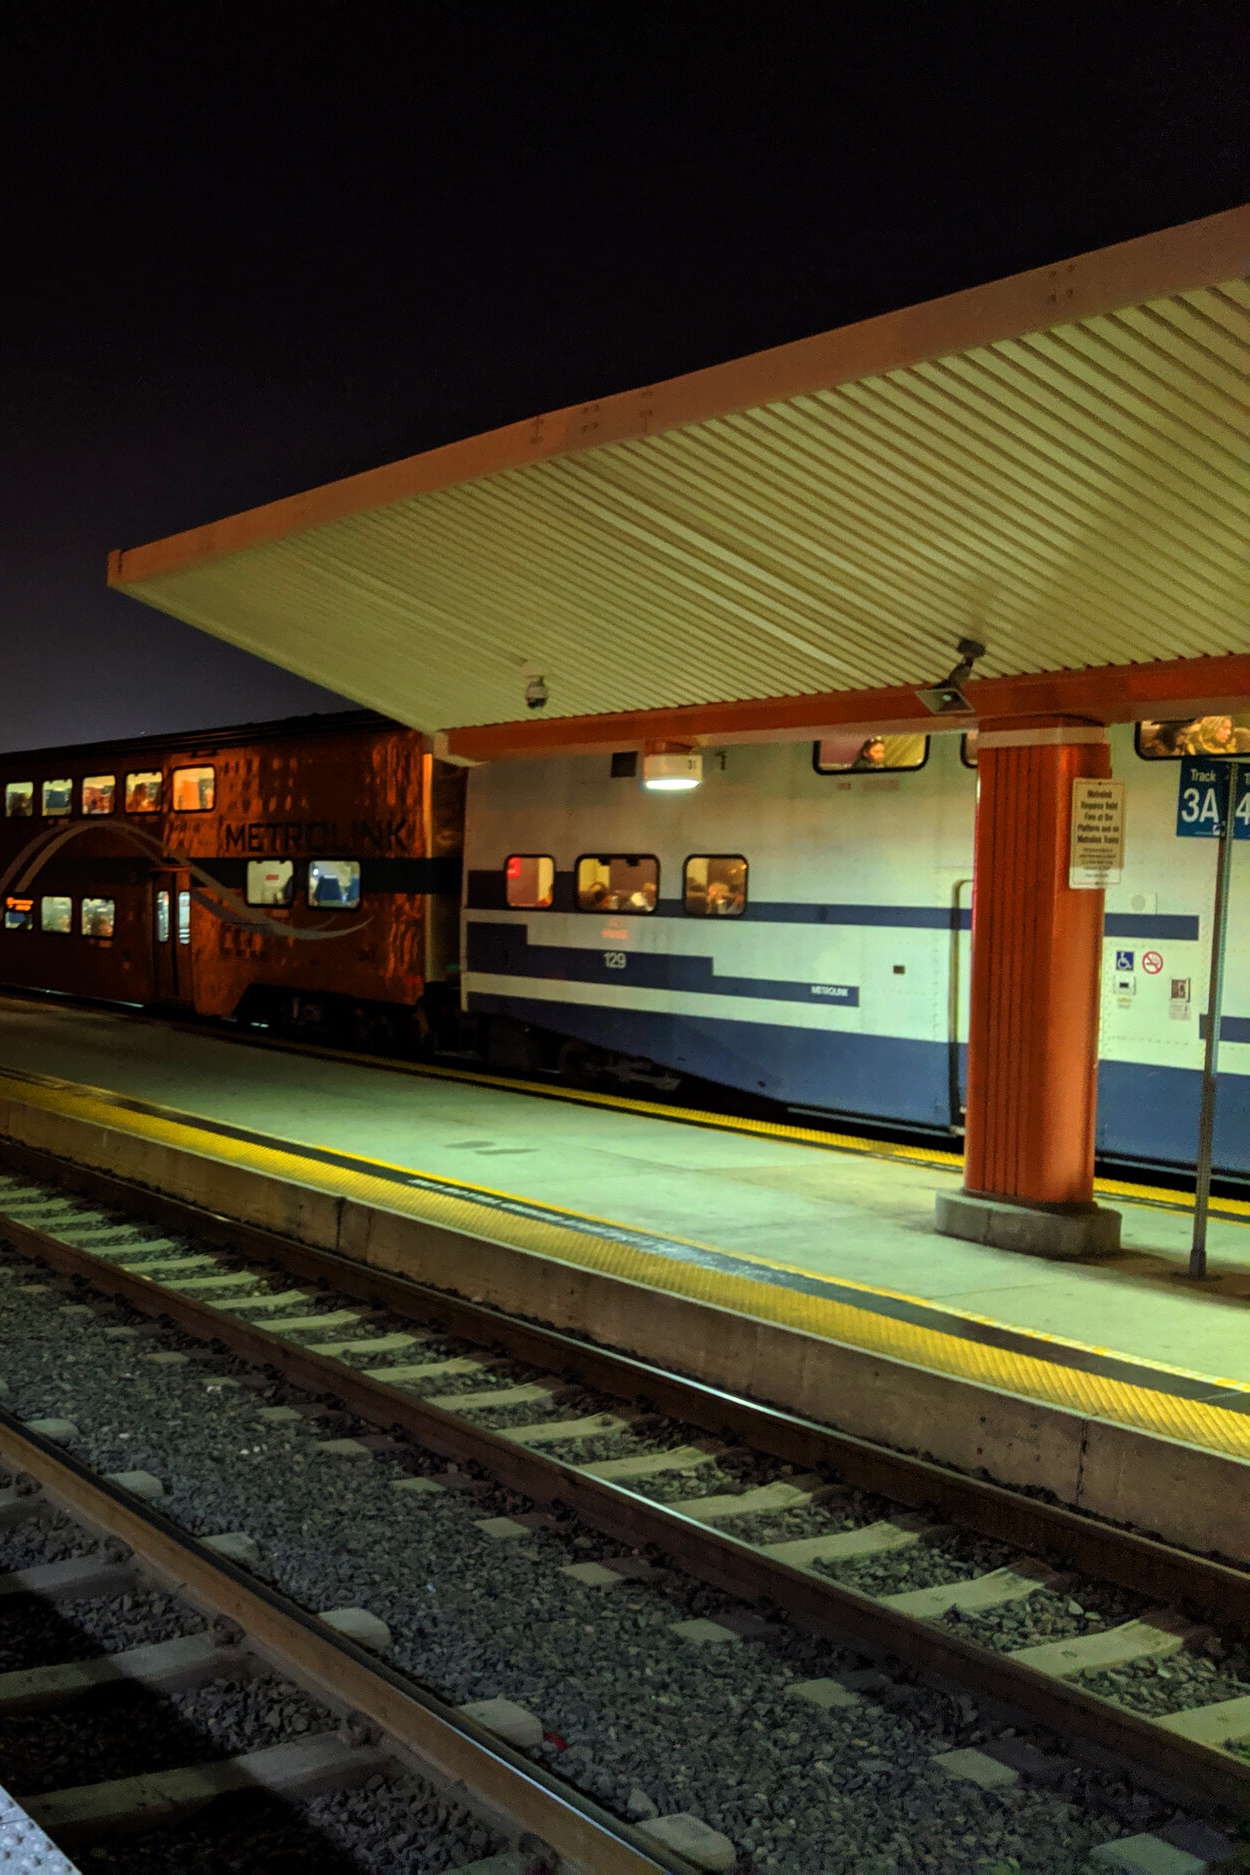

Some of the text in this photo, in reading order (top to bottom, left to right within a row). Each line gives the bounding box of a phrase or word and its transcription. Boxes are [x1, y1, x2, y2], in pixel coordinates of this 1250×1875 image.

[1191, 768, 1216, 782] Track
[1181, 787, 1219, 823] 3A
[225, 819, 408, 853] METROLINK
[603, 952, 626, 969] 129
